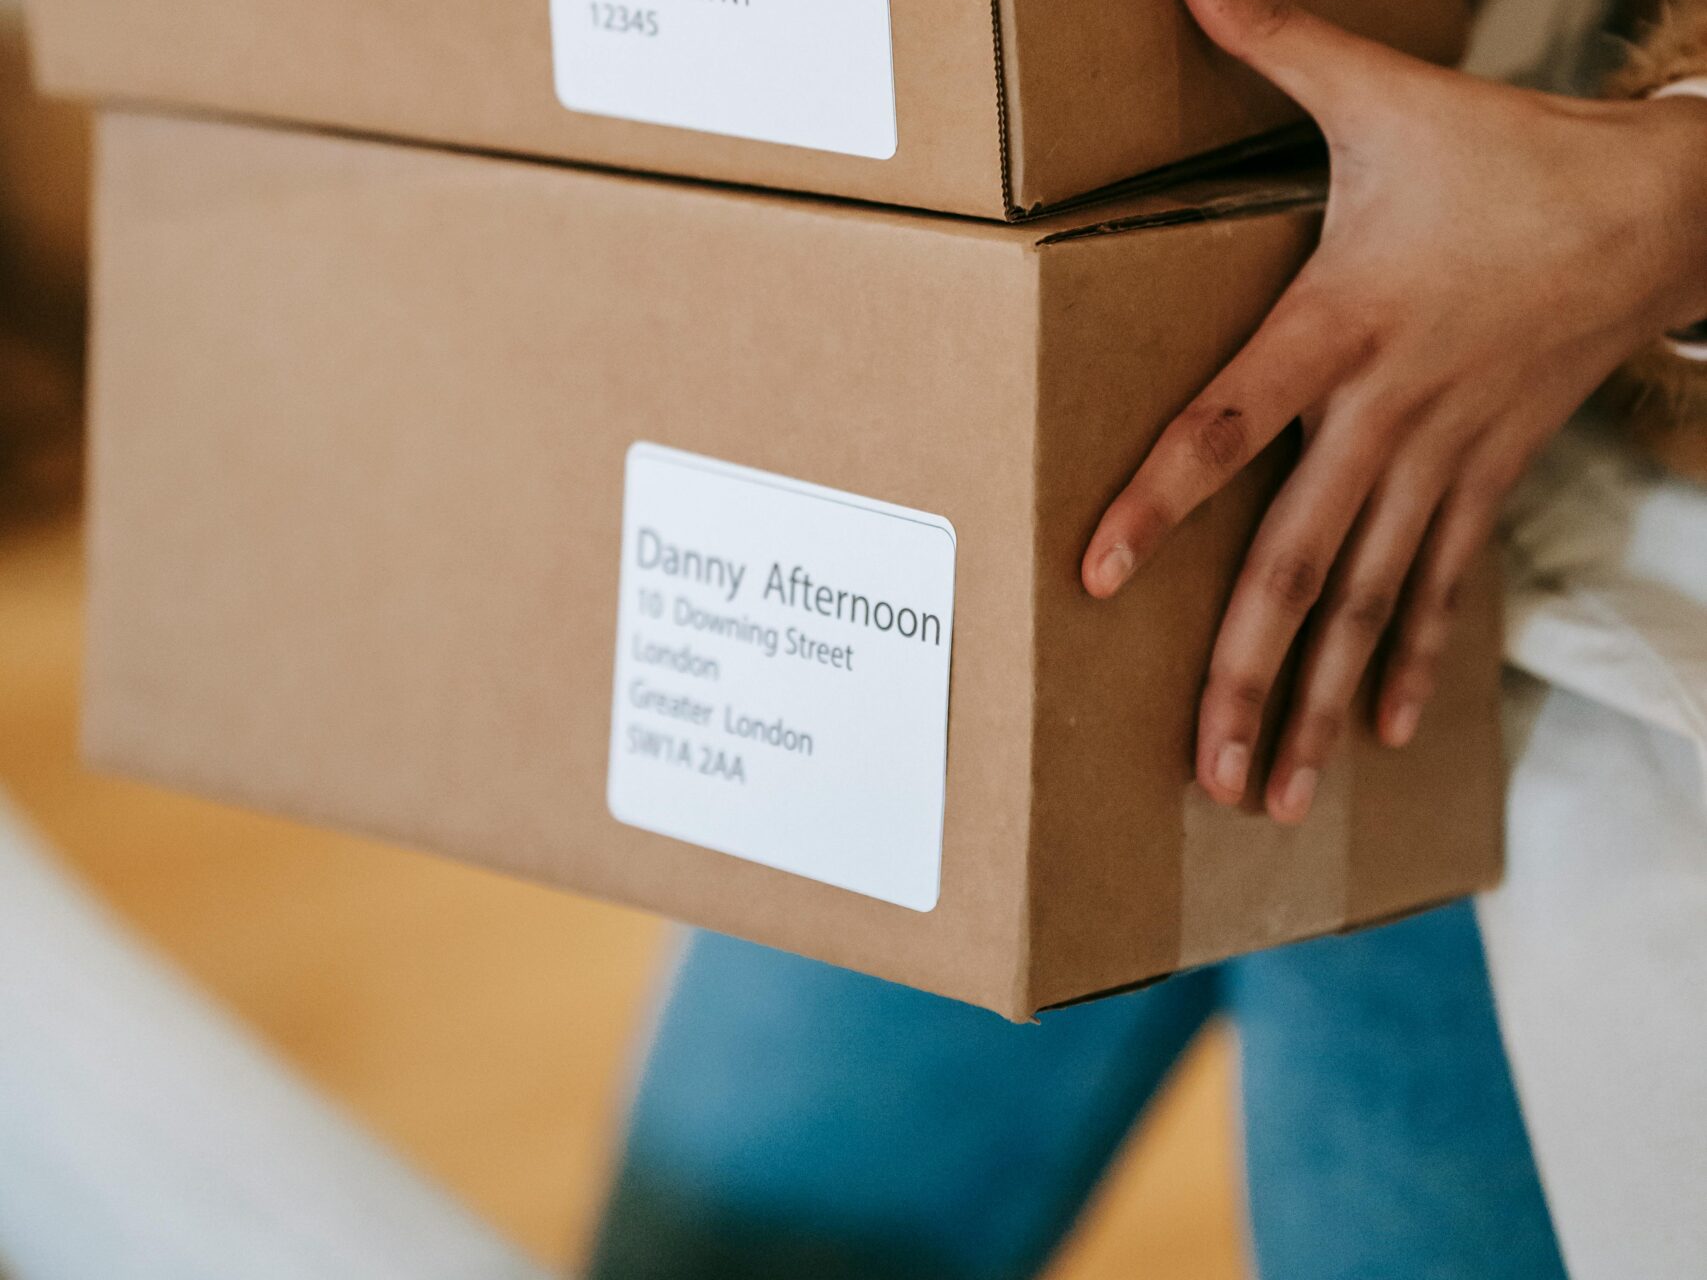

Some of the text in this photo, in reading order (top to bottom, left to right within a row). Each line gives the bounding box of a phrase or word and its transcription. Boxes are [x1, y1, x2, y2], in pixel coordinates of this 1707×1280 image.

[589, 2, 659, 37] 12345
[637, 528, 941, 646] Danny Afternoon
[632, 634, 720, 681] London
[637, 590, 853, 672] 10 Downing Street
[629, 680, 813, 756] Greater London
[626, 726, 746, 785] SW1A 2AA
